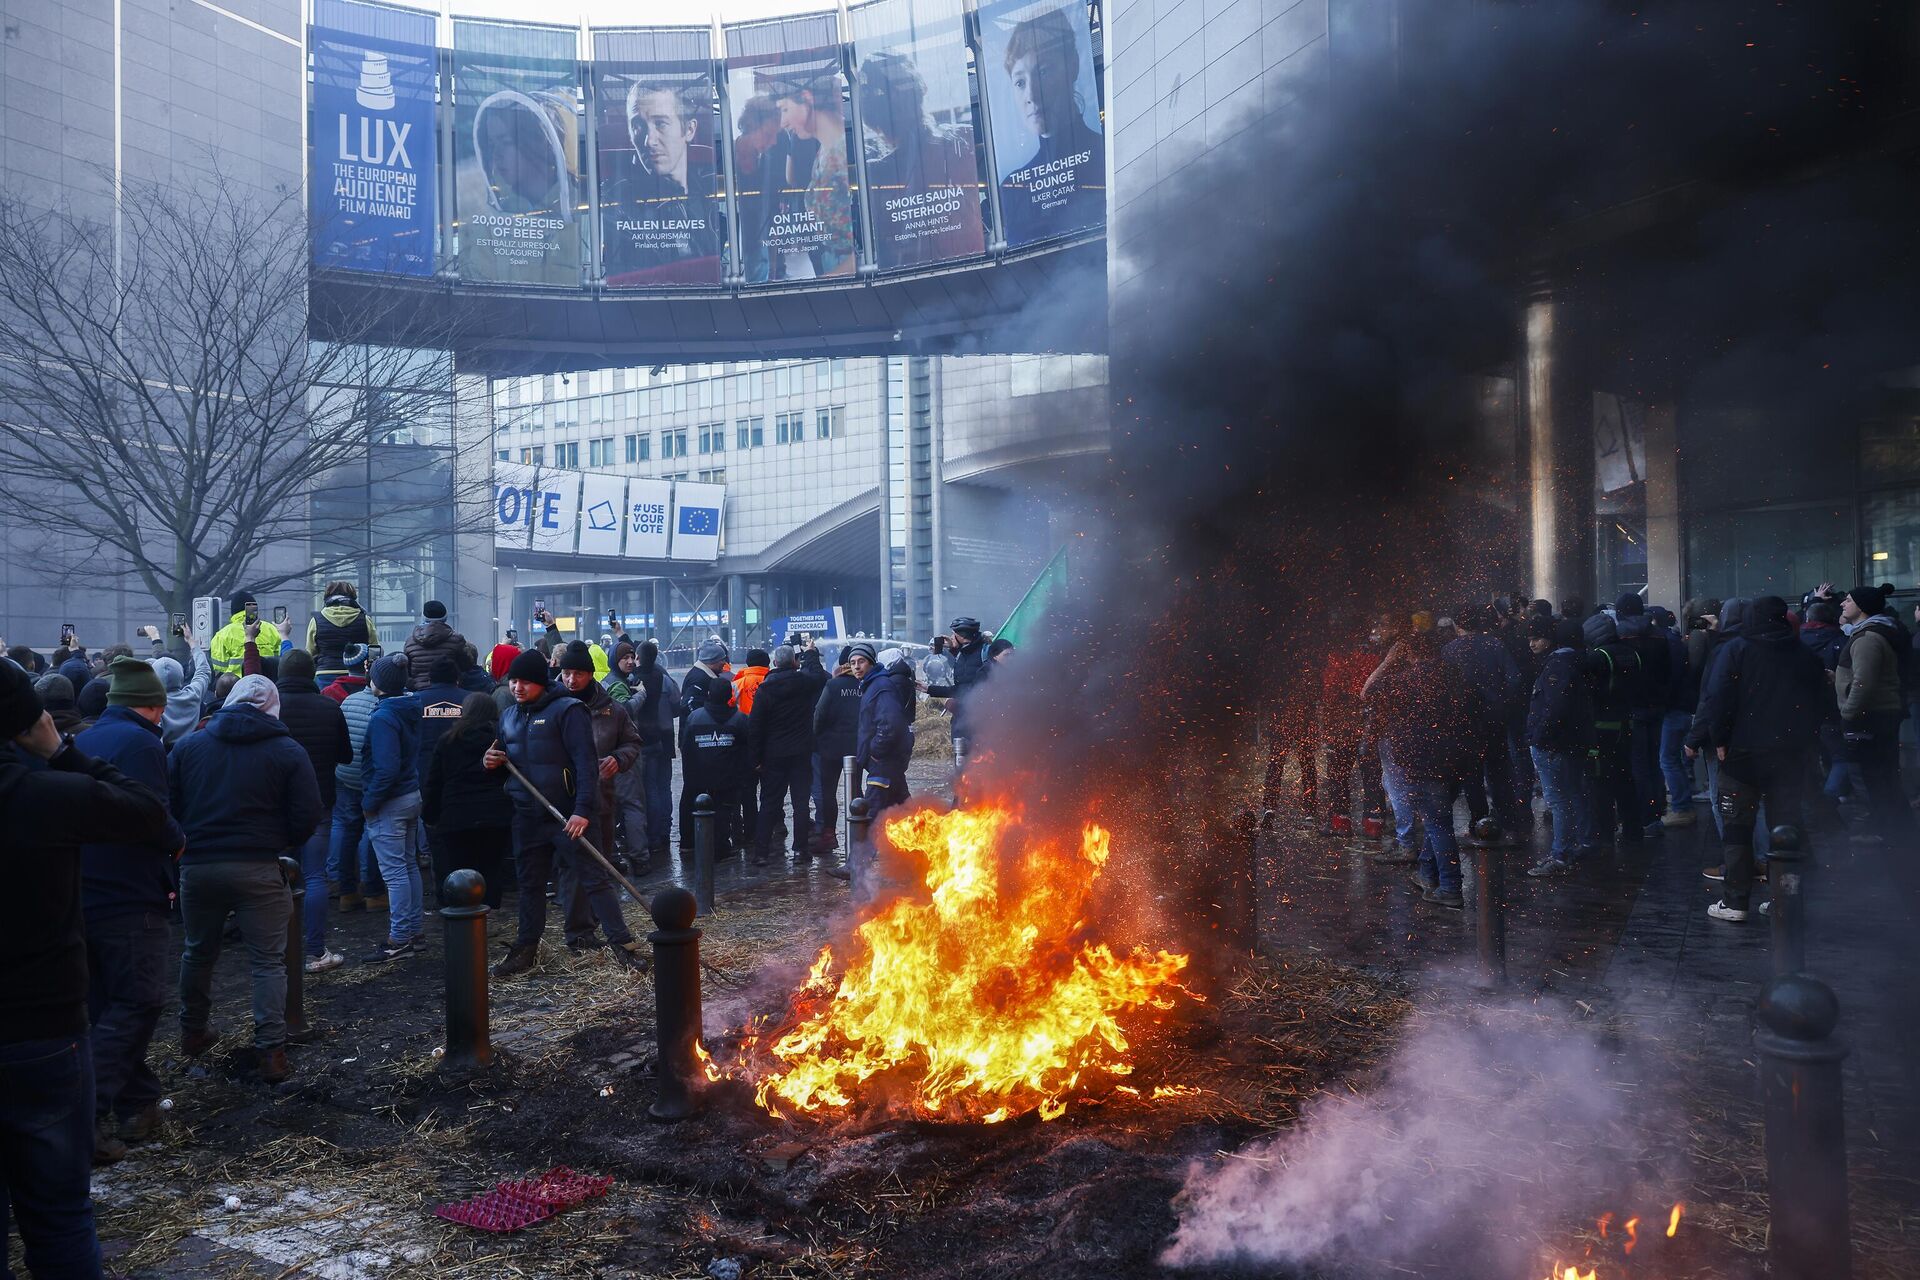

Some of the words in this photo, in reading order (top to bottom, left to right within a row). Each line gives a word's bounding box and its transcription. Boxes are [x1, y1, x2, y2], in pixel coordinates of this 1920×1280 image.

[339, 113, 412, 169] LUX
[1010, 169, 1031, 184] THE
[1032, 150, 1091, 178] TEACHERS'
[333, 162, 355, 178] THE
[358, 166, 417, 187] EUROPEAN
[1030, 170, 1075, 193] LOUNGE
[333, 177, 417, 205] AUDIENCE
[1052, 184, 1076, 198] ÇATAK
[885, 194, 924, 211] SMOKE
[925, 187, 964, 202] SAUNA
[1041, 198, 1068, 210] Germany
[339, 198, 366, 214] FILM
[368, 202, 411, 219] AWARD
[891, 200, 961, 222] SISTERHOOD
[472, 214, 512, 227] 20,000
[515, 217, 564, 230] SPECIES
[616, 220, 659, 231] FALLEN
[662, 219, 706, 230] LEAVES
[773, 213, 791, 225] ON
[793, 211, 816, 222] THE
[905, 220, 927, 231] ANNA
[927, 215, 949, 226] HINTS
[493, 227, 510, 237] OF
[513, 228, 544, 239] BEES
[768, 221, 825, 237] ADAMANT
[940, 222, 962, 233] Iceland
[476, 238, 516, 248] ESTIBALIZ
[518, 241, 561, 251] URRESOLA
[660, 241, 689, 249] Germany
[762, 237, 795, 247] NICOLAS
[796, 233, 833, 244] PHILIBERT
[494, 248, 544, 257] SOLAGUREN
[801, 245, 819, 253] Japan
[633, 503, 665, 514] #USE
[633, 513, 664, 524] YOUR
[633, 524, 663, 534] VOTE
[790, 622, 825, 630] DEMOCRACY
